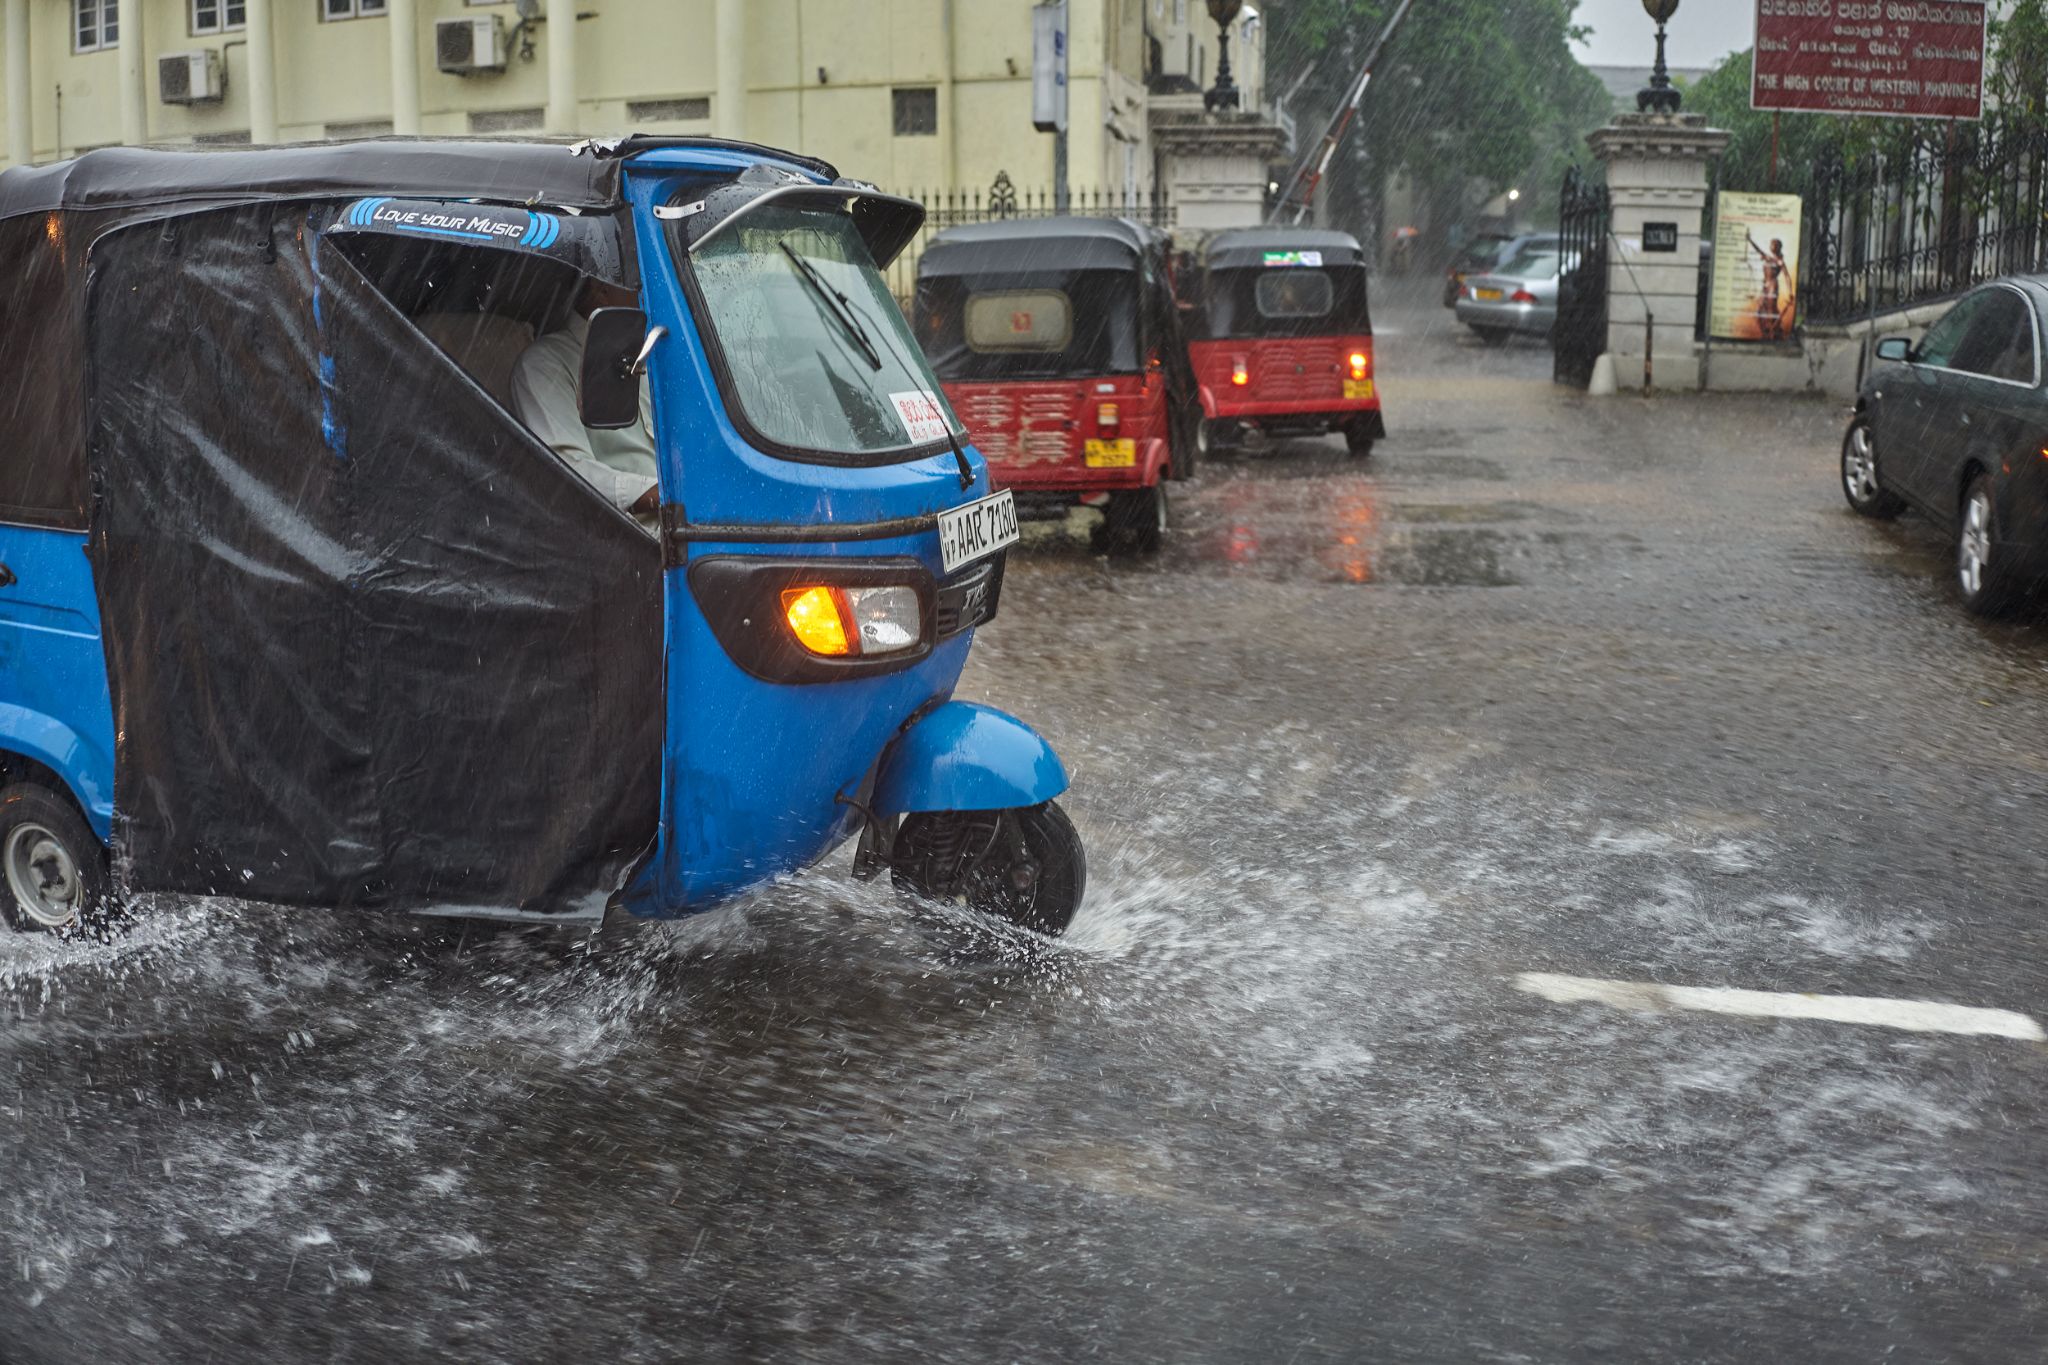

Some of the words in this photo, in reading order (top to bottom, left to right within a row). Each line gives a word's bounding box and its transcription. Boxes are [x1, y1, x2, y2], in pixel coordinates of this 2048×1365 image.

[1758, 74, 1778, 90] THE
[1783, 74, 1810, 91] HIGH
[1814, 76, 1851, 92] COURT
[1853, 76, 1867, 93] OF
[1871, 79, 1920, 95] WESTERN
[1925, 81, 1978, 99] PROVINCE
[944, 539, 956, 565] WP
[957, 509, 988, 558] AAR
[986, 498, 1017, 544] 7180
